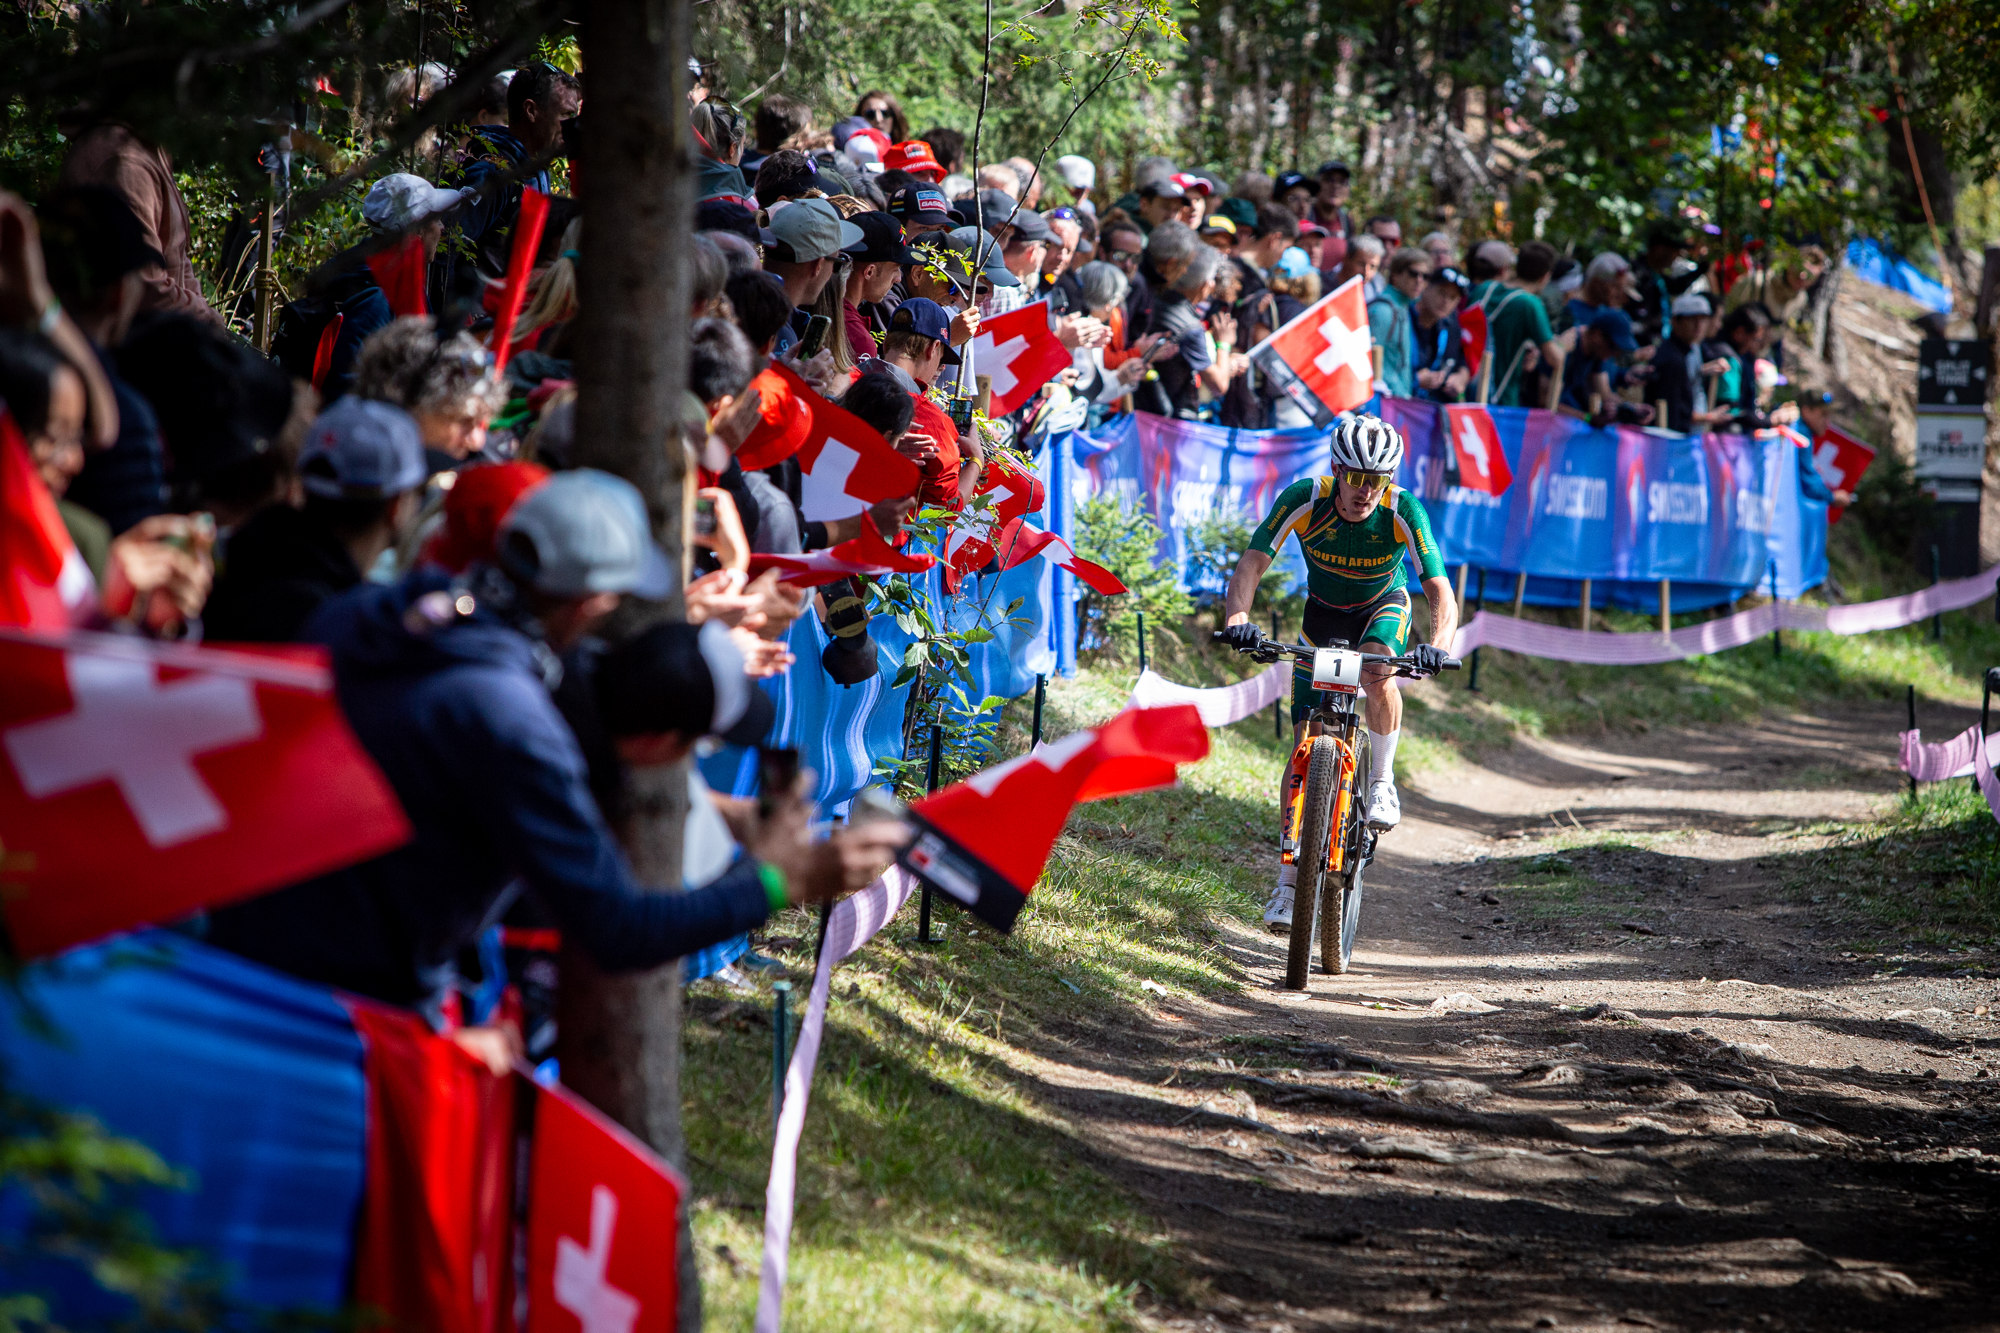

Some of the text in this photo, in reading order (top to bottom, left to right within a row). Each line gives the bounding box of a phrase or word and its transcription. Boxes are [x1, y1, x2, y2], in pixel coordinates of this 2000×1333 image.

[1306, 545, 1393, 567] SOUTH AFRICA
[1333, 658, 1342, 677] 1
